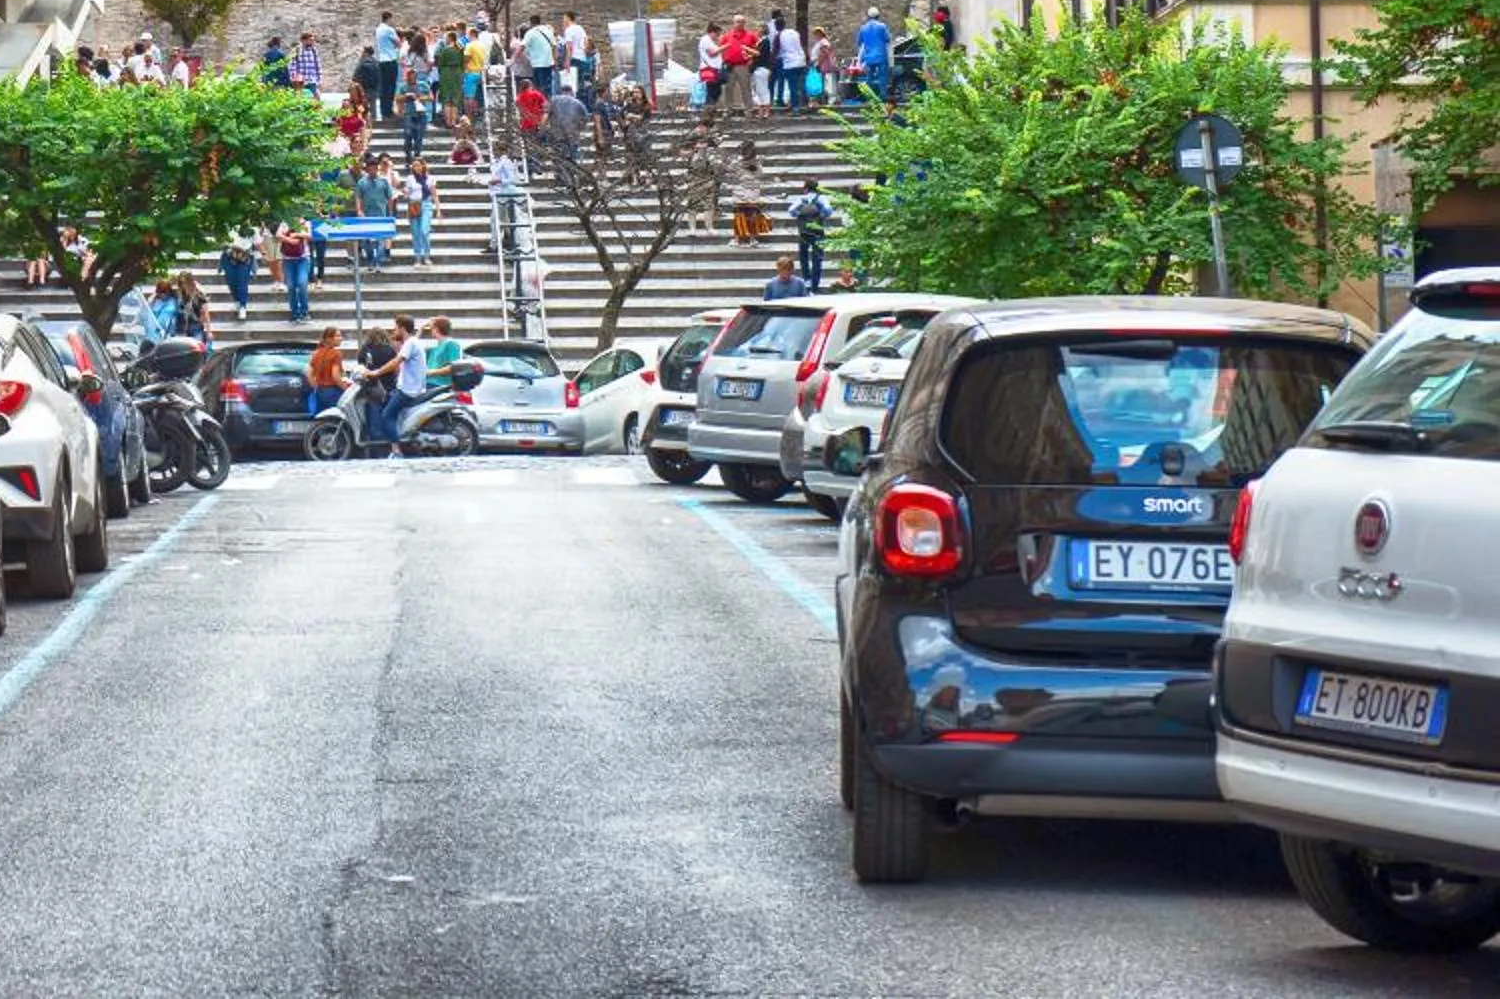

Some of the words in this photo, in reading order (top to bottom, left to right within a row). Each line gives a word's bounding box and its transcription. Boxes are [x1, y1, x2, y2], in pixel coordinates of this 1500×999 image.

[1143, 497, 1203, 513] smart
[1095, 546, 1133, 578] EY
[1148, 547, 1232, 581] 076E
[1316, 674, 1349, 715] ET
[1353, 682, 1431, 728] 800KB
